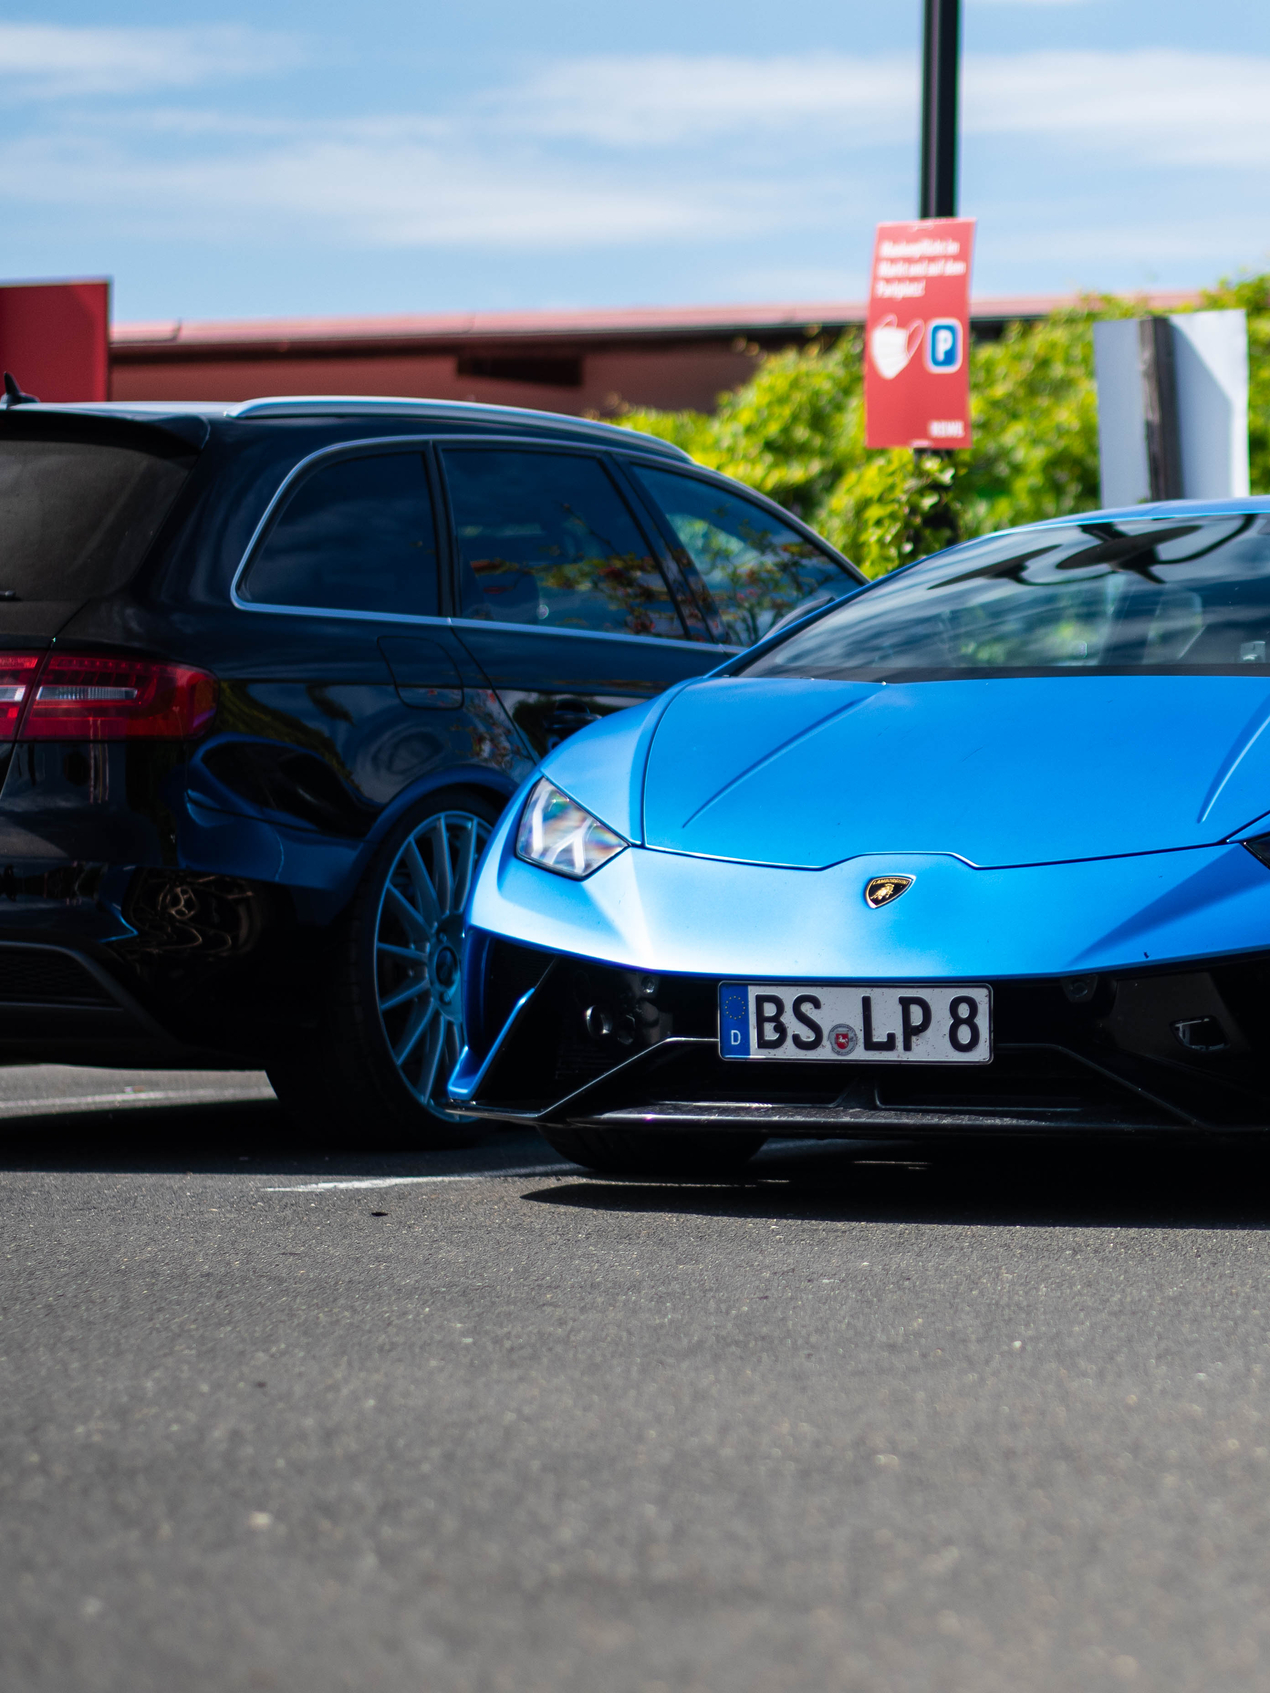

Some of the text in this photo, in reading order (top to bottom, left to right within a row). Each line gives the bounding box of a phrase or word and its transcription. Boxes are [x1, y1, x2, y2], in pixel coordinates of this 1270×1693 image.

[935, 329, 953, 361] P
[730, 1030, 741, 1045] D
[755, 993, 823, 1051] BS
[861, 995, 932, 1052] LP
[948, 995, 980, 1053] 8
